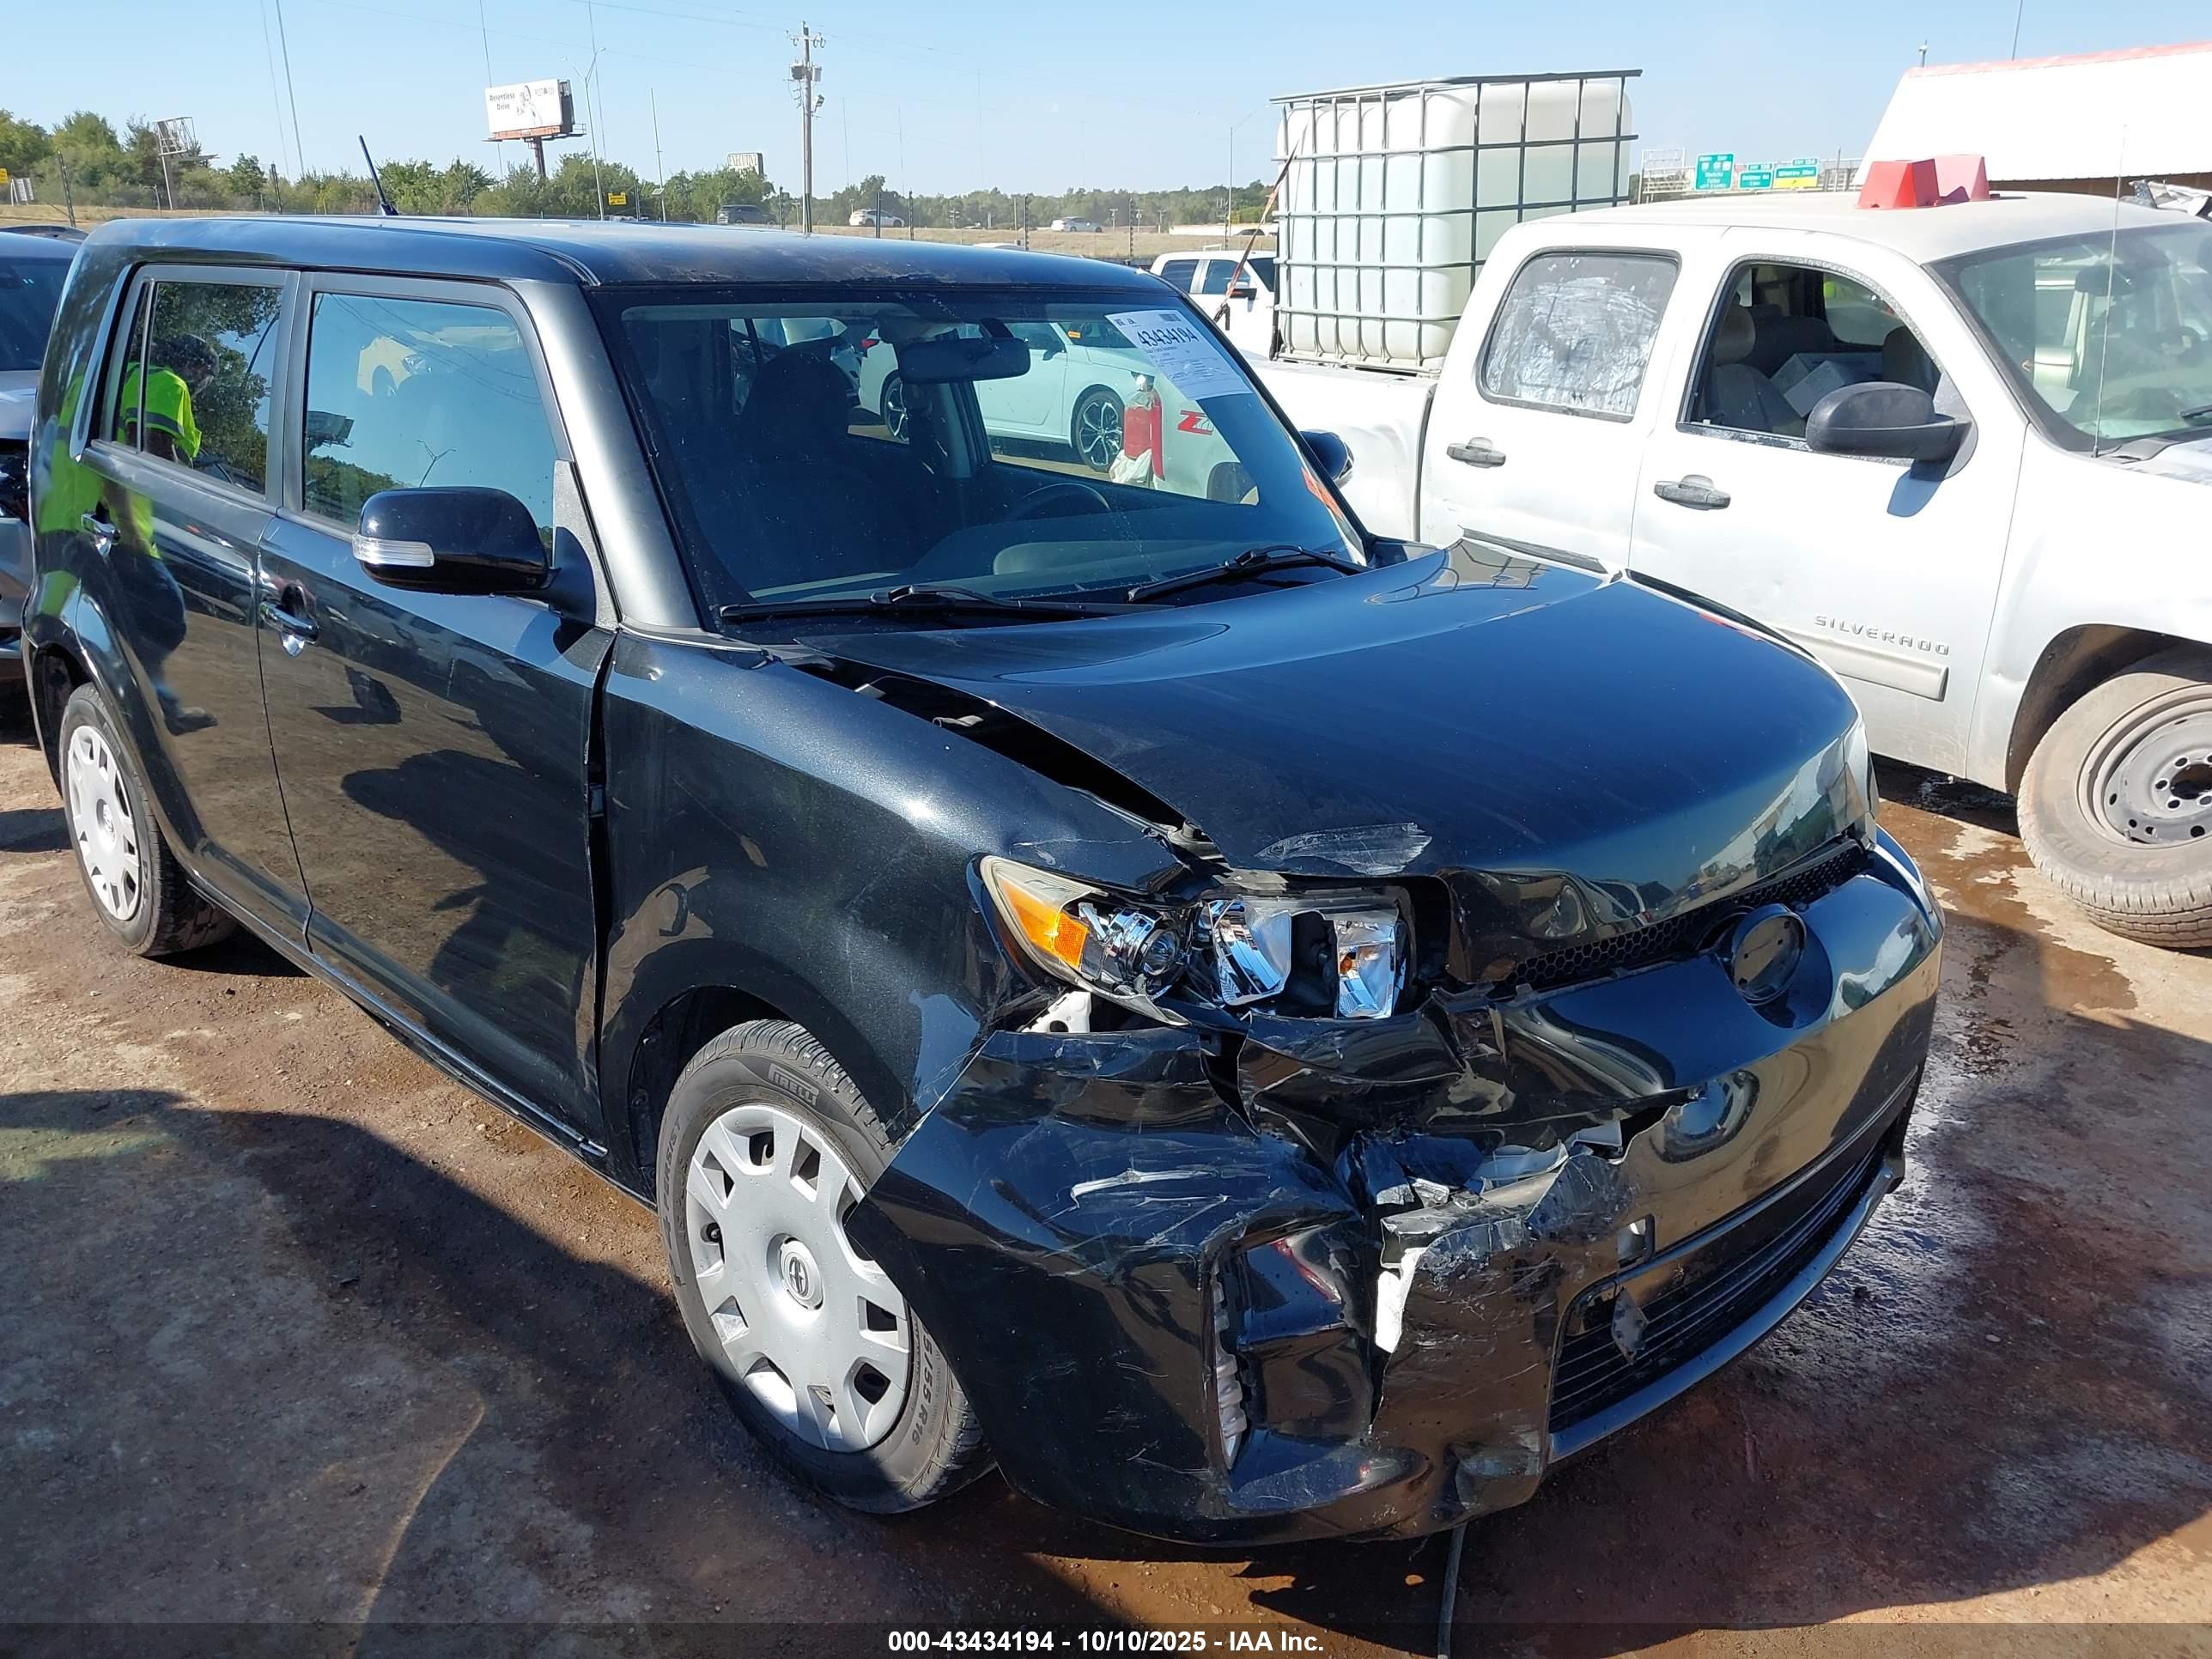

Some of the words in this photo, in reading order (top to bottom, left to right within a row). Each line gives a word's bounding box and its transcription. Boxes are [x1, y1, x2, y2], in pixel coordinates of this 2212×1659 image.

[1137, 327, 1200, 347] 43434194
[1814, 616, 1950, 655] SILVERADO
[769, 1063, 819, 1106] PIRELLI
